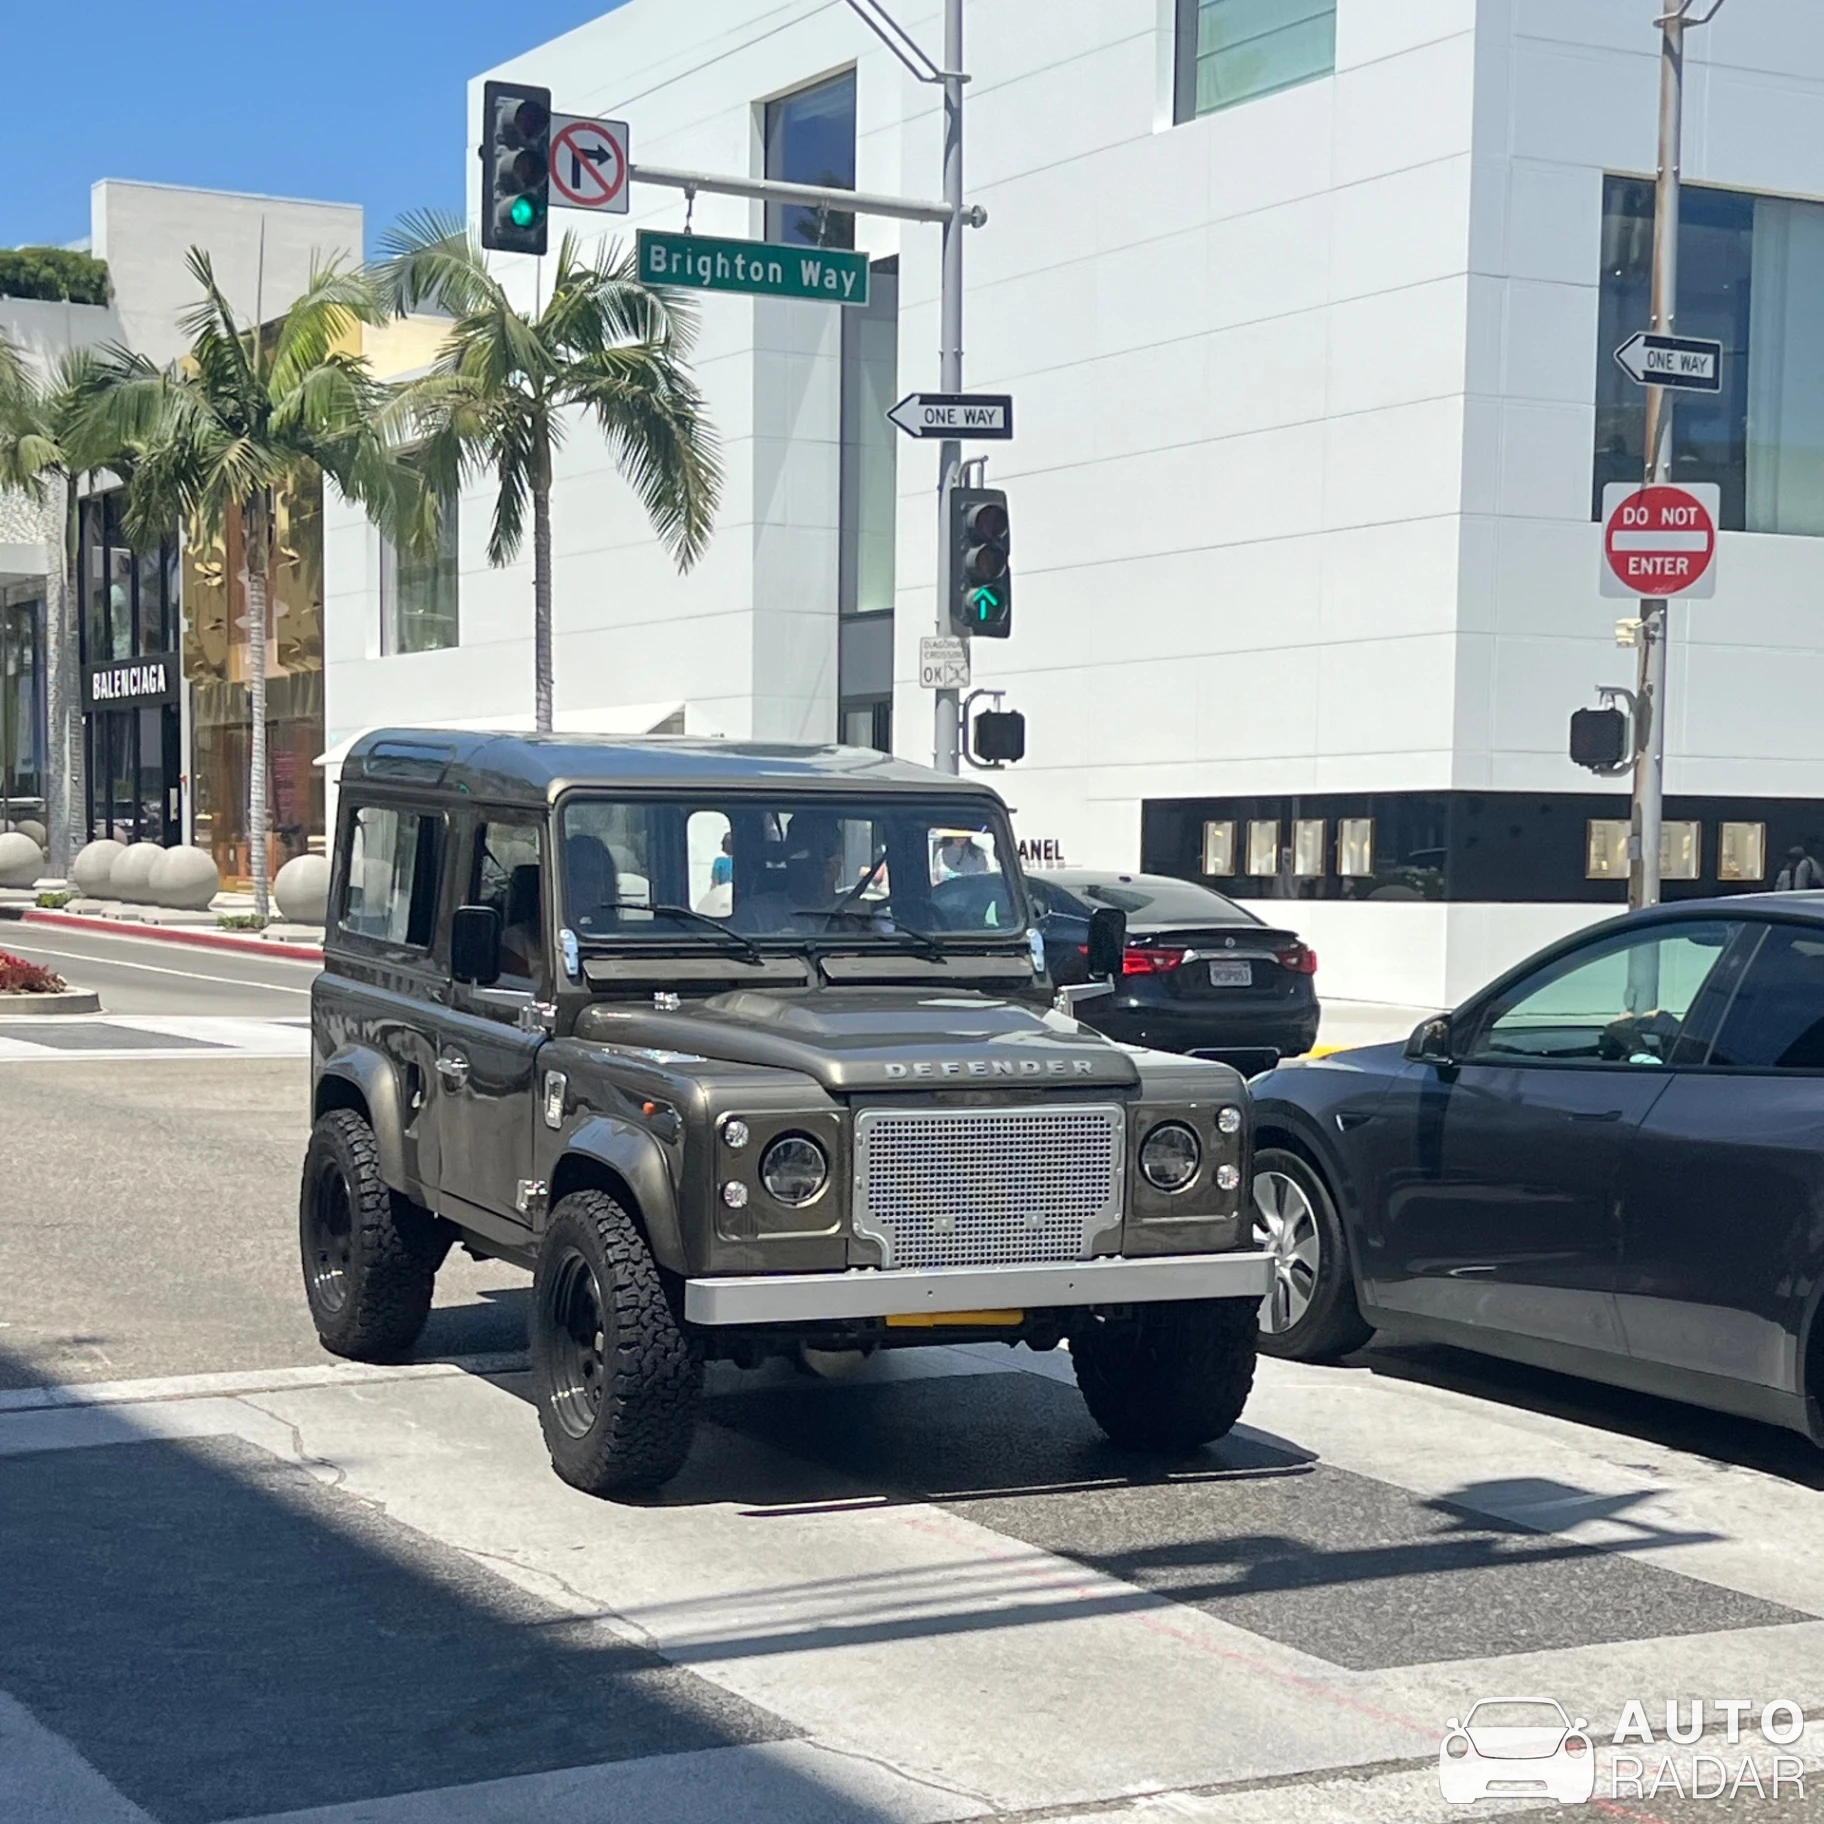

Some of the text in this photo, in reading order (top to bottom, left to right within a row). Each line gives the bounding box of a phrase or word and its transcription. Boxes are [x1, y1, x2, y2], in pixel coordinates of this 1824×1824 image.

[650, 244, 856, 297] Brighton Way
[1647, 350, 1708, 373] ONE WAY
[924, 408, 996, 425] ONE WAY
[1623, 506, 1699, 525] DO NOT
[1628, 557, 1690, 575] ENTER
[92, 663, 167, 701] BALENCIAGA
[924, 666, 943, 683] OK
[1018, 838, 1065, 861] ANEL
[884, 1059, 1094, 1080] DEFENDER
